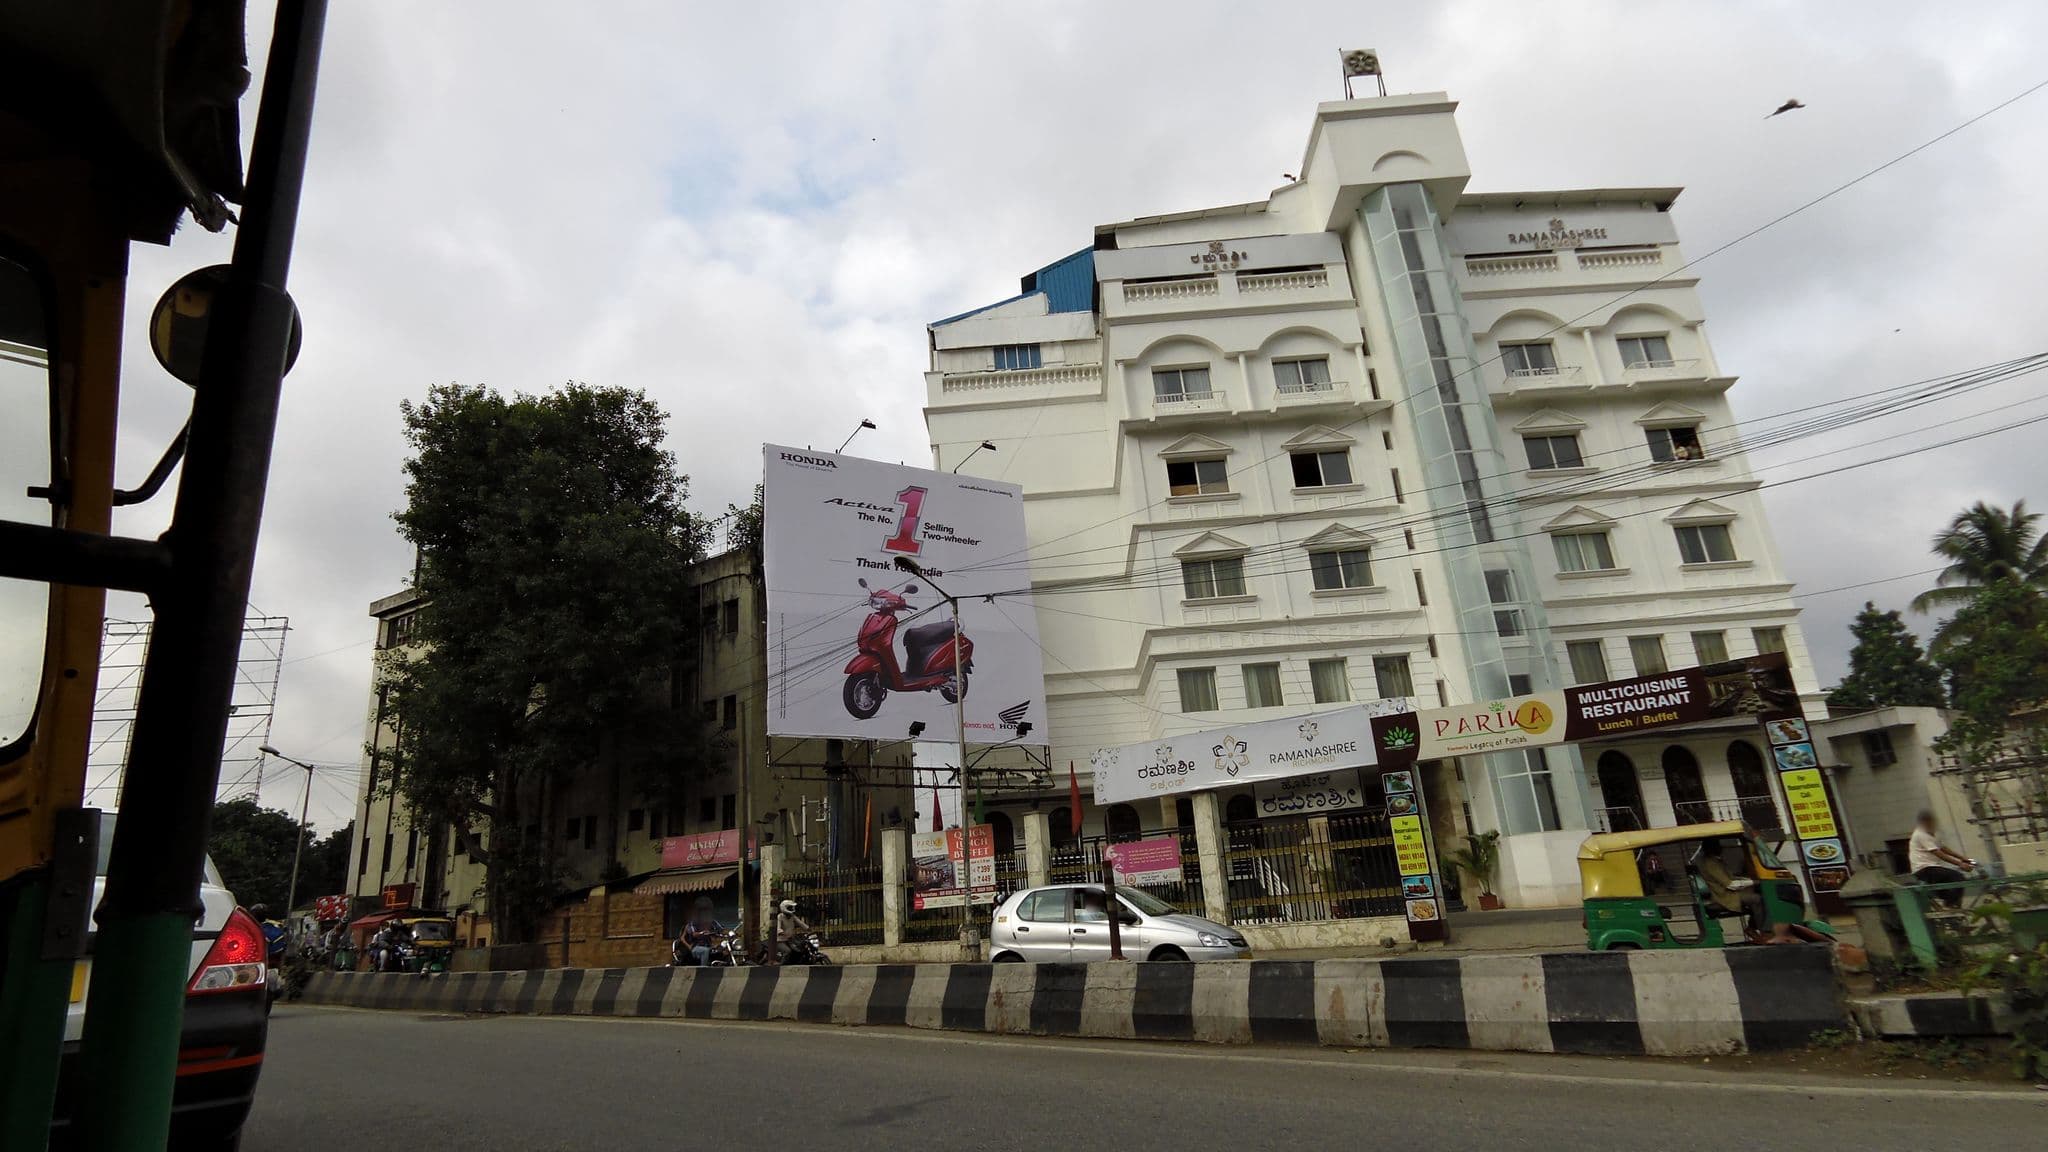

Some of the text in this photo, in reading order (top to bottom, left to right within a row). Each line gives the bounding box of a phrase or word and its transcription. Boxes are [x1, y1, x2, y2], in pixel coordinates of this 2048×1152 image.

[1508, 228, 1608, 244] RAMANASHREE
[780, 452, 838, 469] HONDA
[824, 497, 895, 513] Activa
[858, 485, 928, 558] The No. 1
[924, 522, 954, 535] Selling
[922, 531, 979, 546] Two-wheeler
[856, 557, 891, 572] Thank
[1578, 676, 1688, 704] MULTICUISINE
[1581, 691, 1691, 719] RESTAURANT
[1434, 707, 1545, 737] PARIKA
[1598, 719, 1633, 731] Lunch
[1642, 711, 1679, 725] Buffet
[1470, 740, 1494, 751] Legacy
[1505, 735, 1528, 746] Punjab
[1269, 741, 1357, 764] RAMANASHREE
[1292, 754, 1336, 768] RICHMOND
[1138, 760, 1196, 779] ರಮಣಶ್ರೀ
[1263, 788, 1357, 813] ರಮಣಶ್ರೀ
